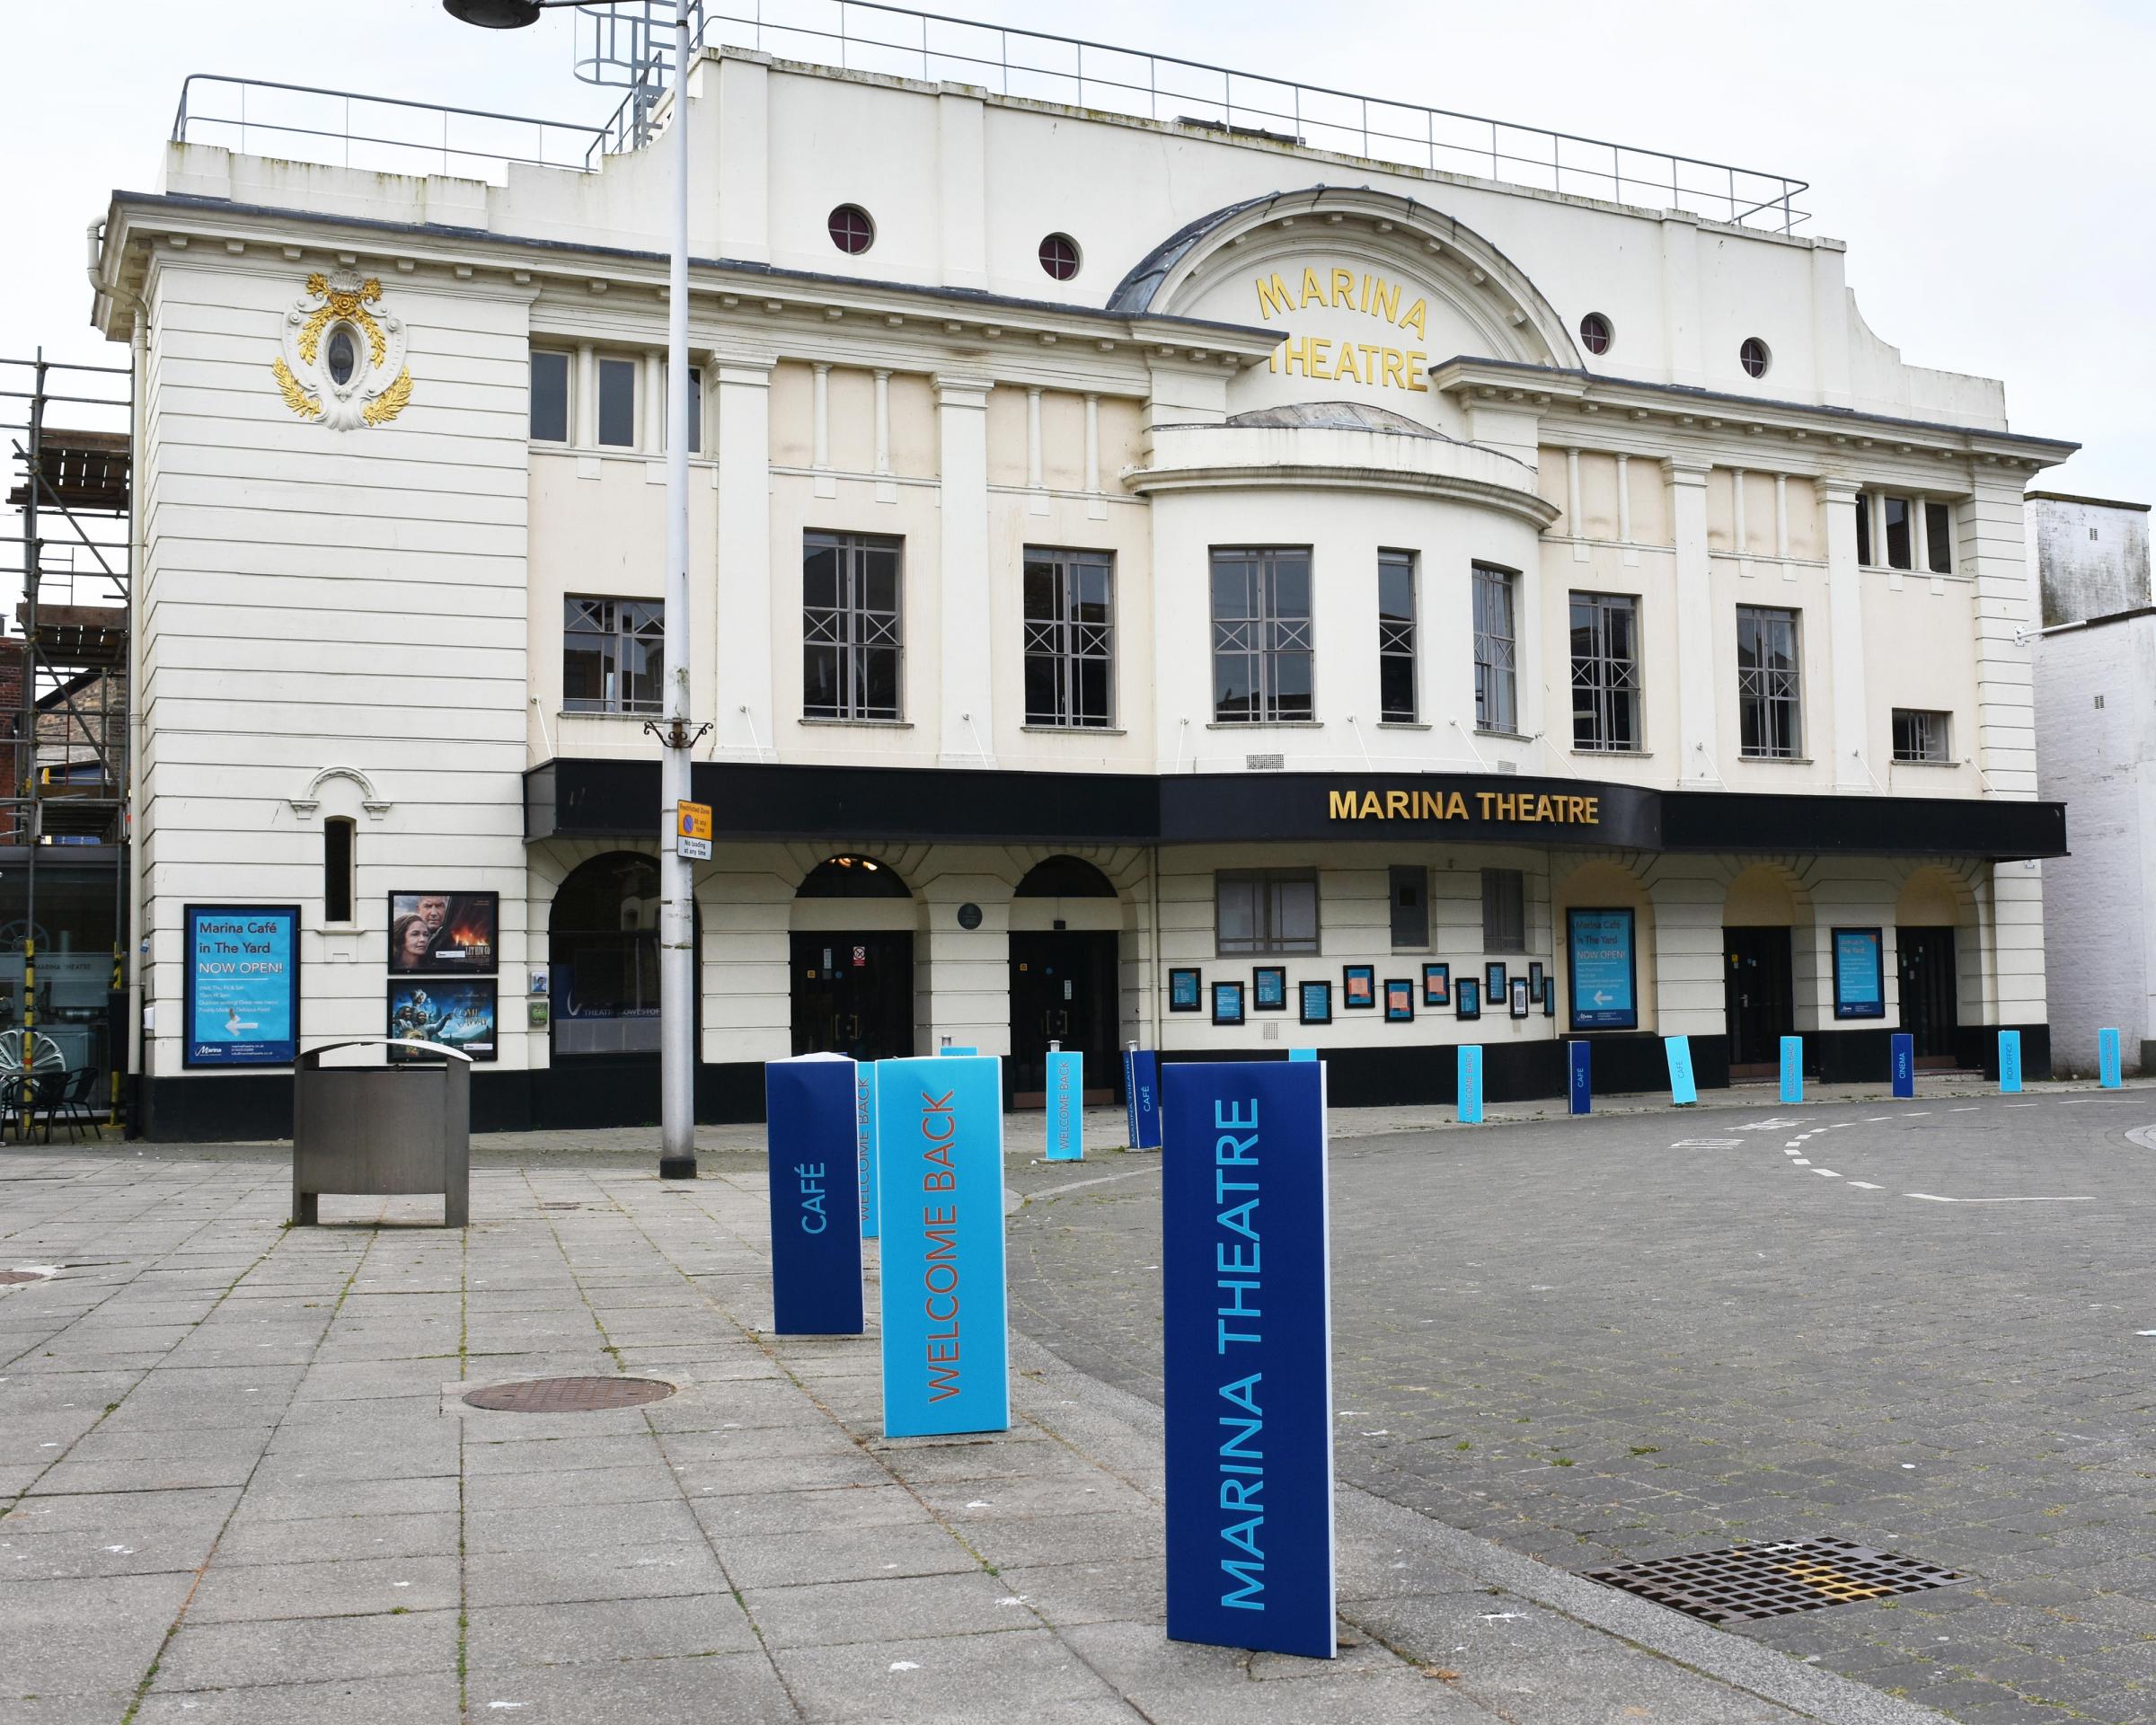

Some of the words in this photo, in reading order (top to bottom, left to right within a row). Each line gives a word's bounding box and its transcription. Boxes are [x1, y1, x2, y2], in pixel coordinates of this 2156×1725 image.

[1256, 266, 1427, 341] MARINA
[1329, 790, 1470, 820] MARINA
[1475, 792, 1599, 824] THEATRE
[199, 922, 243, 933] Marina
[247, 922, 278, 933] Café
[199, 942, 210, 953] in
[215, 942, 239, 953] The
[243, 942, 271, 953] Yard
[199, 962, 236, 974] NOW
[240, 962, 283, 974] OPEN!
[1577, 951, 1597, 960] NOW
[1058, 1062, 1069, 1091] BACK
[1898, 1052, 1906, 1079] CINEMA
[858, 1077, 870, 1126] BACK
[1140, 1085, 1151, 1112] CAFÉ
[1465, 1075, 1473, 1116] WELCOME
[922, 1089, 957, 1192] BACK
[1059, 1094, 1069, 1150] WELCOME
[794, 1162, 826, 1234] CAFÉ
[858, 1130, 870, 1222] WELCOME
[1215, 1098, 1261, 1355] THEATRE
[924, 1205, 960, 1403] WELCOME
[1219, 1372, 1266, 1611] MARINA
